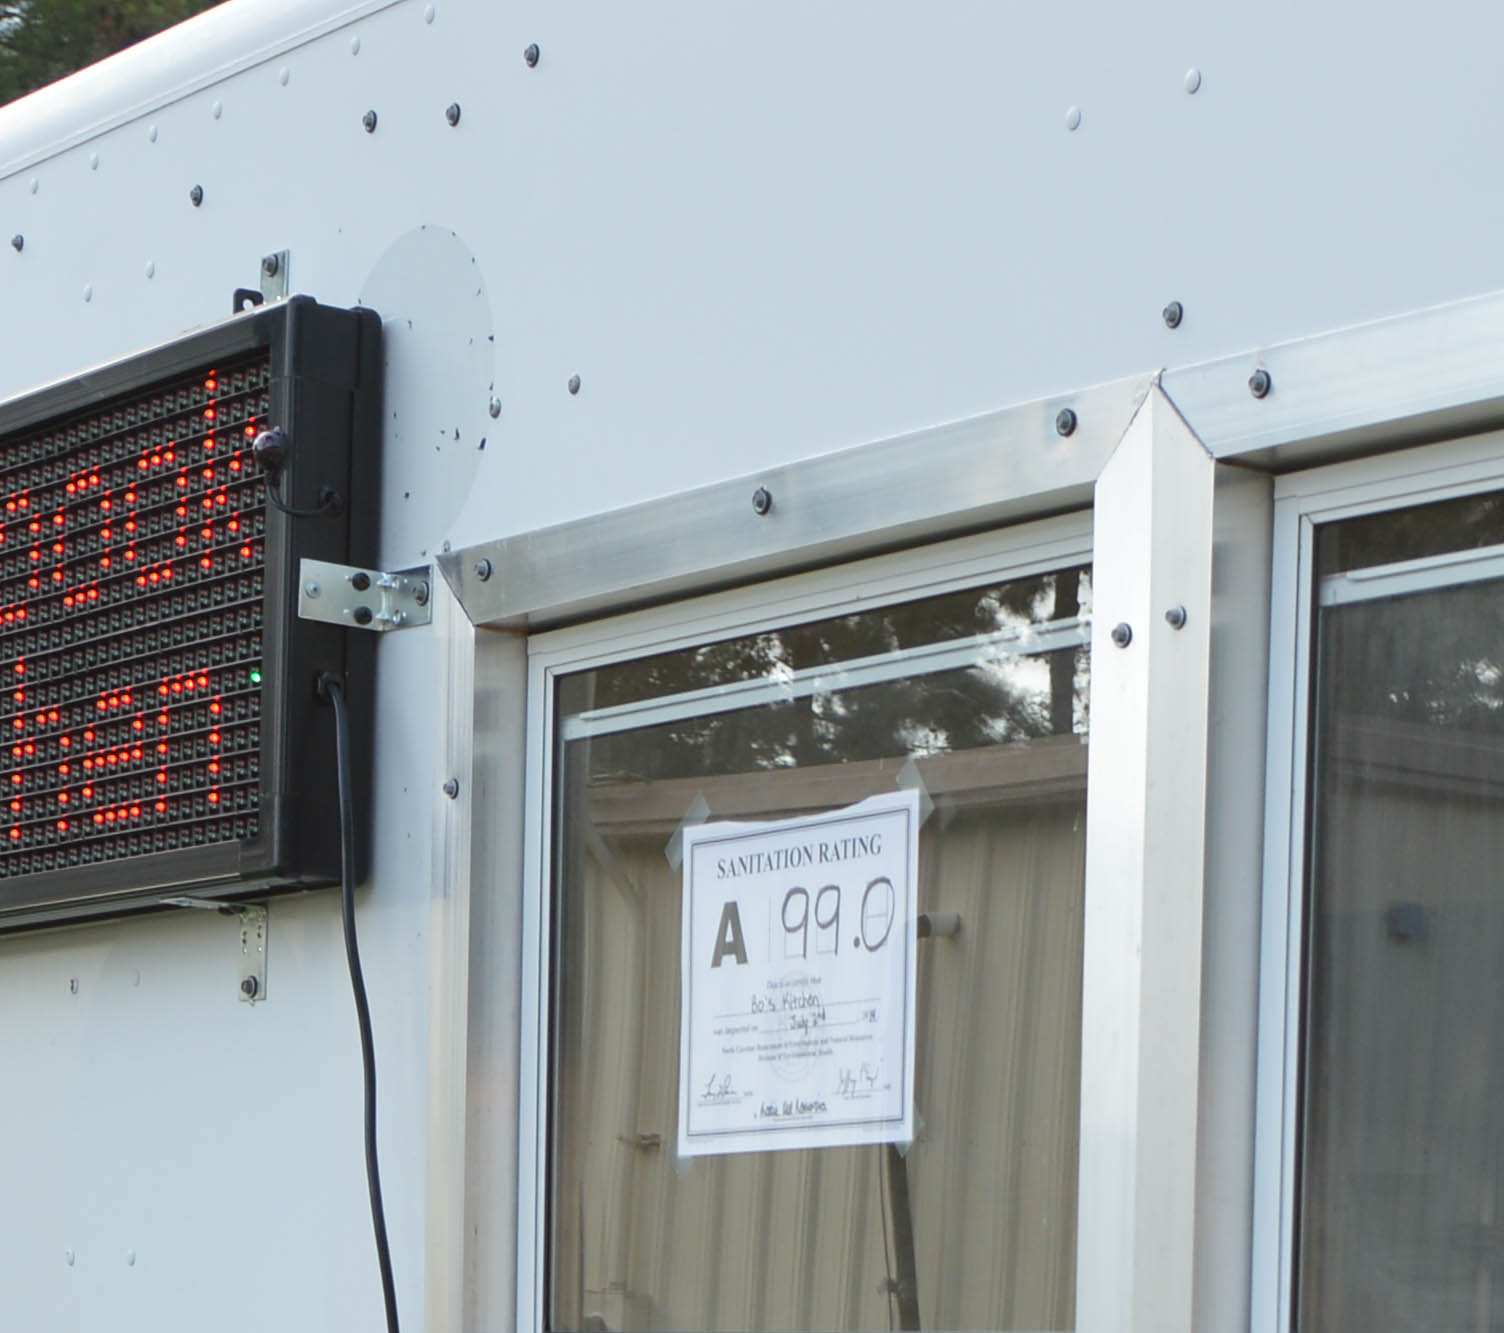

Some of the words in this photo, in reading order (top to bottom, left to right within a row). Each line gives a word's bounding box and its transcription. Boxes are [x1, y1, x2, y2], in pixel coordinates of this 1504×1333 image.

[715, 844, 814, 880] SANITATION
[818, 832, 883, 865] RATING
[710, 901, 749, 969] A
[781, 876, 896, 961] 99.0
